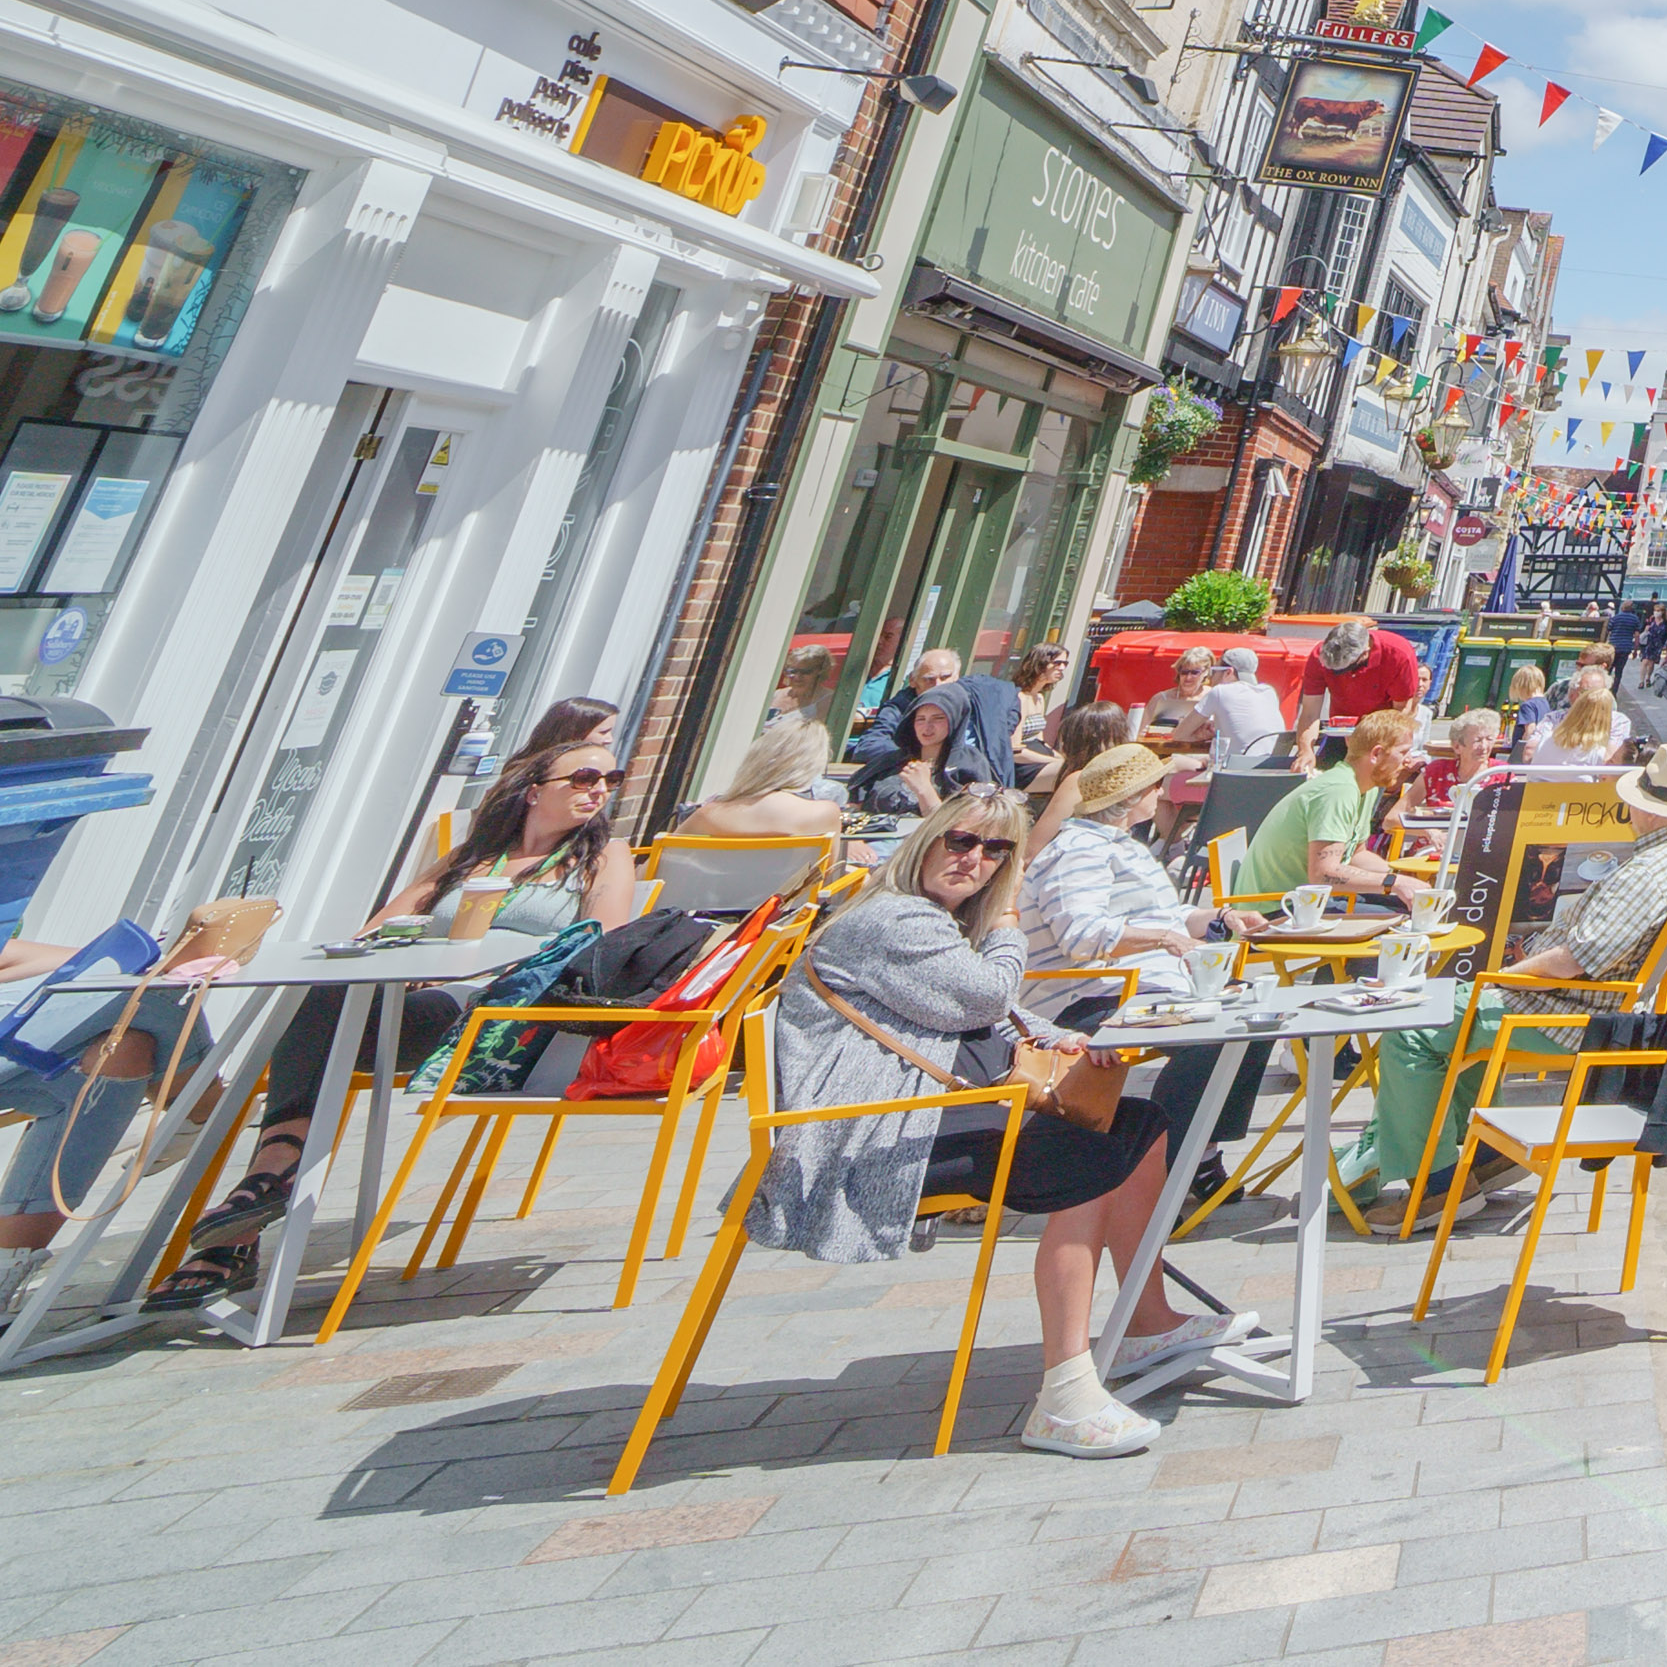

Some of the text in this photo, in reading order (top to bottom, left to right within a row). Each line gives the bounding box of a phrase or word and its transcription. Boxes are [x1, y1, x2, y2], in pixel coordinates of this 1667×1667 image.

[568, 31, 602, 61] cafe
[1318, 23, 1410, 48] FULLER'S
[558, 59, 593, 85] pies
[530, 76, 583, 121] pastry
[495, 97, 570, 139] patisserie
[655, 122, 767, 218] PICKUP
[1264, 165, 1380, 189] THE OX ROW INN
[1032, 145, 1125, 250] stones
[1009, 229, 1100, 315] kitchen cafe
[1204, 299, 1230, 333] INN
[1455, 526, 1482, 534] COSTA
[1565, 802, 1632, 825] PICKU
[1457, 871, 1498, 923] day
